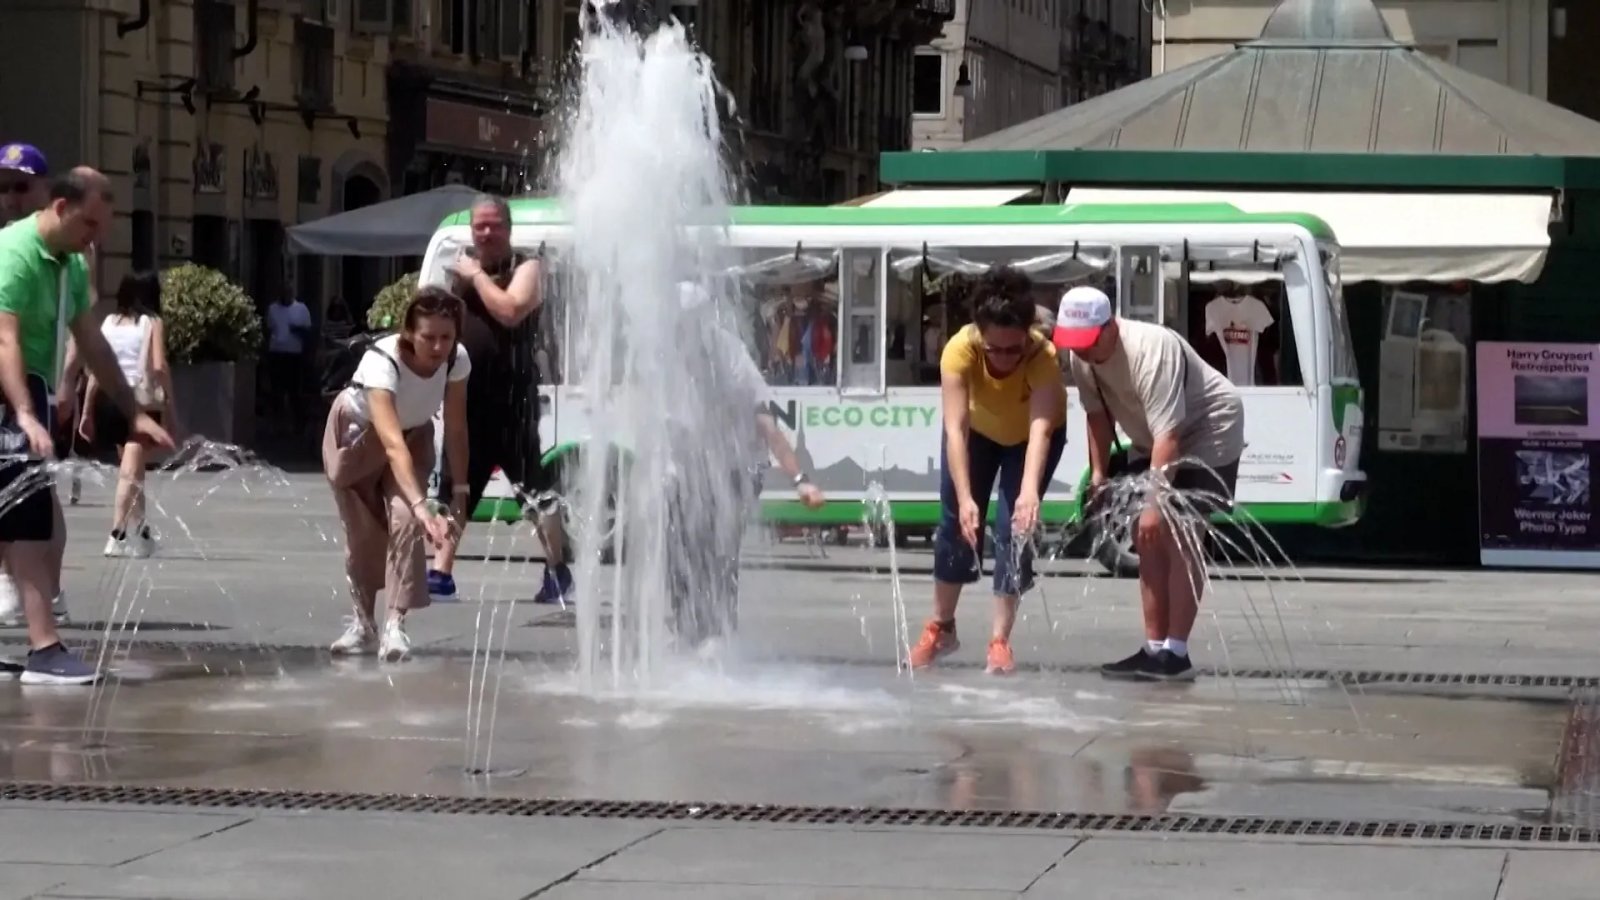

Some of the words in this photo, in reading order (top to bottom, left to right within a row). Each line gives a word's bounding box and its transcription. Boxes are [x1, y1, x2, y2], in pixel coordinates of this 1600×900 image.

[1507, 349, 1539, 361] Harry
[806, 406, 863, 427] ECO
[870, 406, 936, 427] CITY
[1514, 508, 1556, 519] Werner
